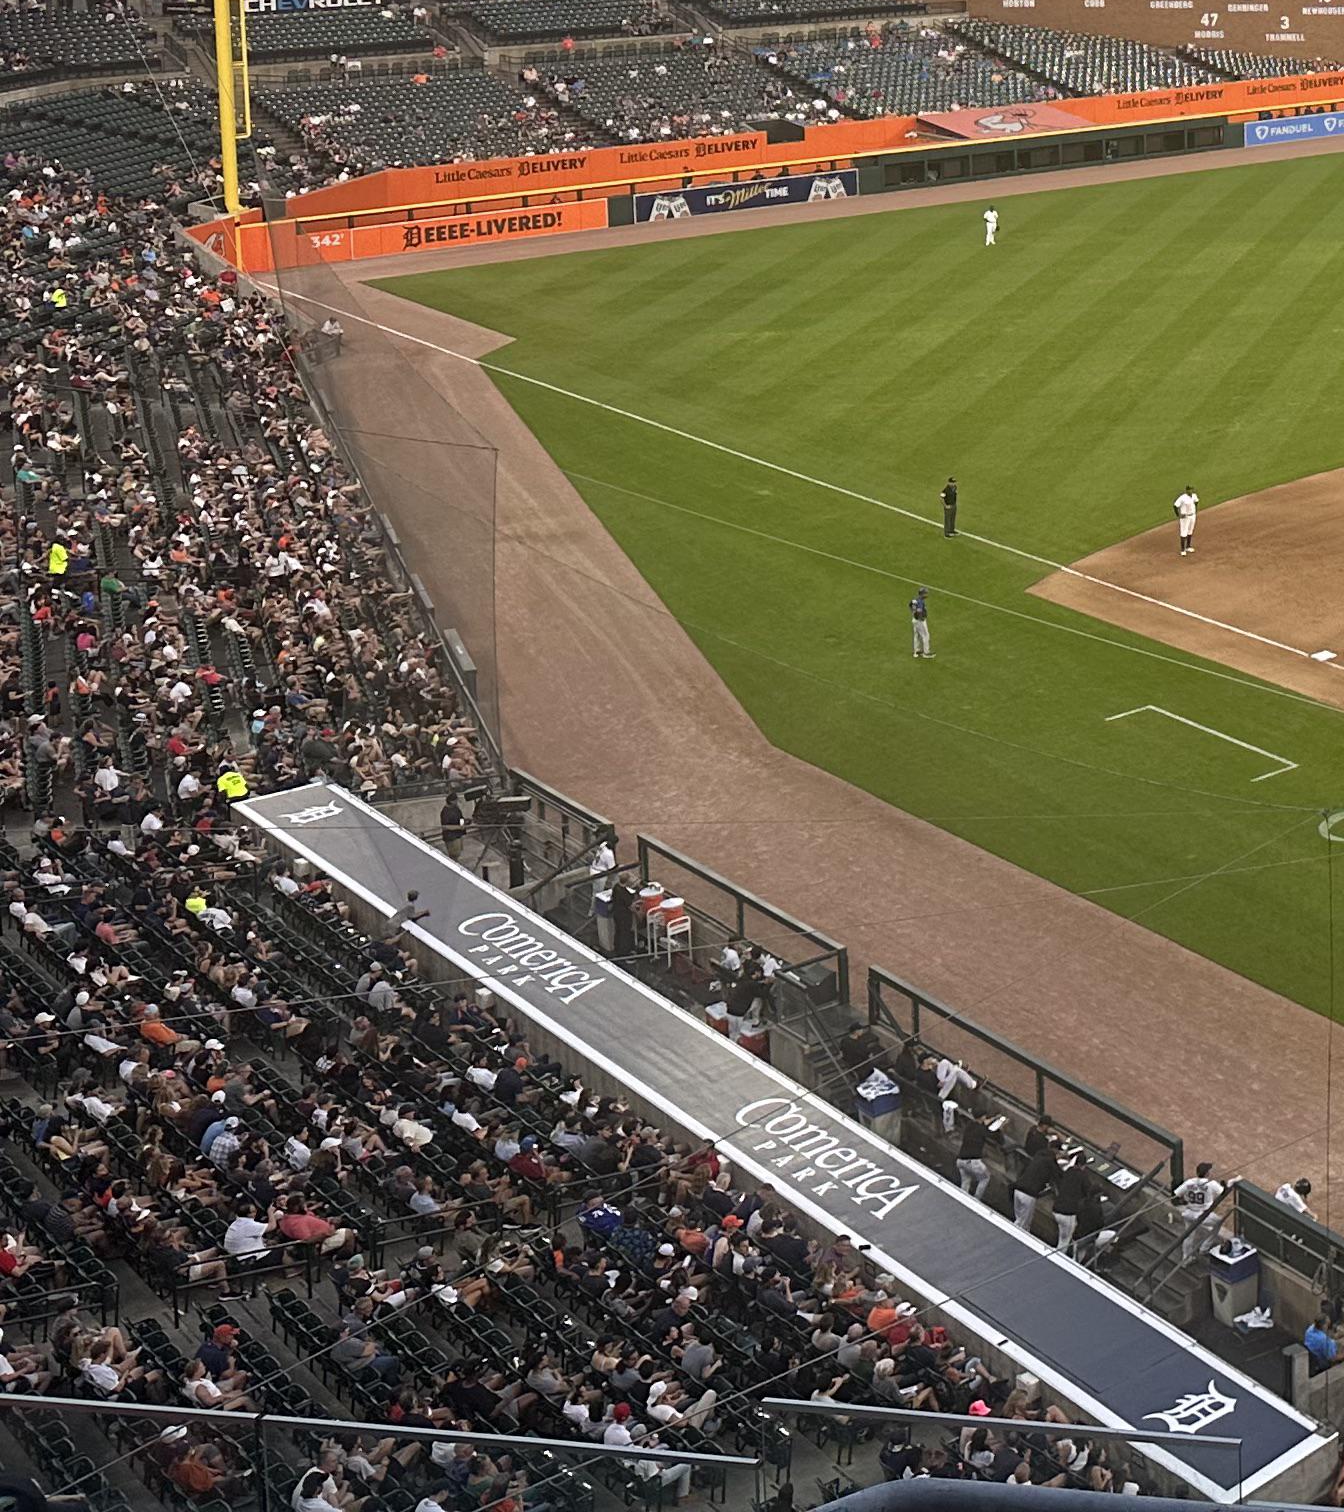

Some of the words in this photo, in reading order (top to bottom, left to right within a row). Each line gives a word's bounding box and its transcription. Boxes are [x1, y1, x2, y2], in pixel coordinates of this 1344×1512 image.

[1201, 13, 1218, 27] 47
[1281, 16, 1289, 30] 3
[1247, 86, 1266, 95] Little
[1267, 83, 1296, 93] Caesars
[1300, 76, 1344, 91] DELIVERY
[1117, 99, 1138, 110] Little
[1140, 97, 1172, 107] Caesars
[1175, 90, 1224, 105] DELIVERY
[1271, 124, 1313, 135] FANDUEL
[620, 152, 648, 164] Little
[649, 149, 689, 161] Caesars
[695, 139, 758, 157] DELIVERY
[435, 169, 466, 184] Little
[468, 166, 512, 181] Caesars
[518, 157, 587, 176] DELIVERY
[766, 187, 788, 199] TIME
[311, 233, 345, 248] 342'
[403, 212, 562, 251] DEEEE-LIVERED!
[457, 911, 607, 1005] Comerica
[468, 944, 539, 989] PARK
[735, 1098, 920, 1220] Comerica
[753, 1140, 839, 1198] PARK
[1188, 1191, 1205, 1204] 99
